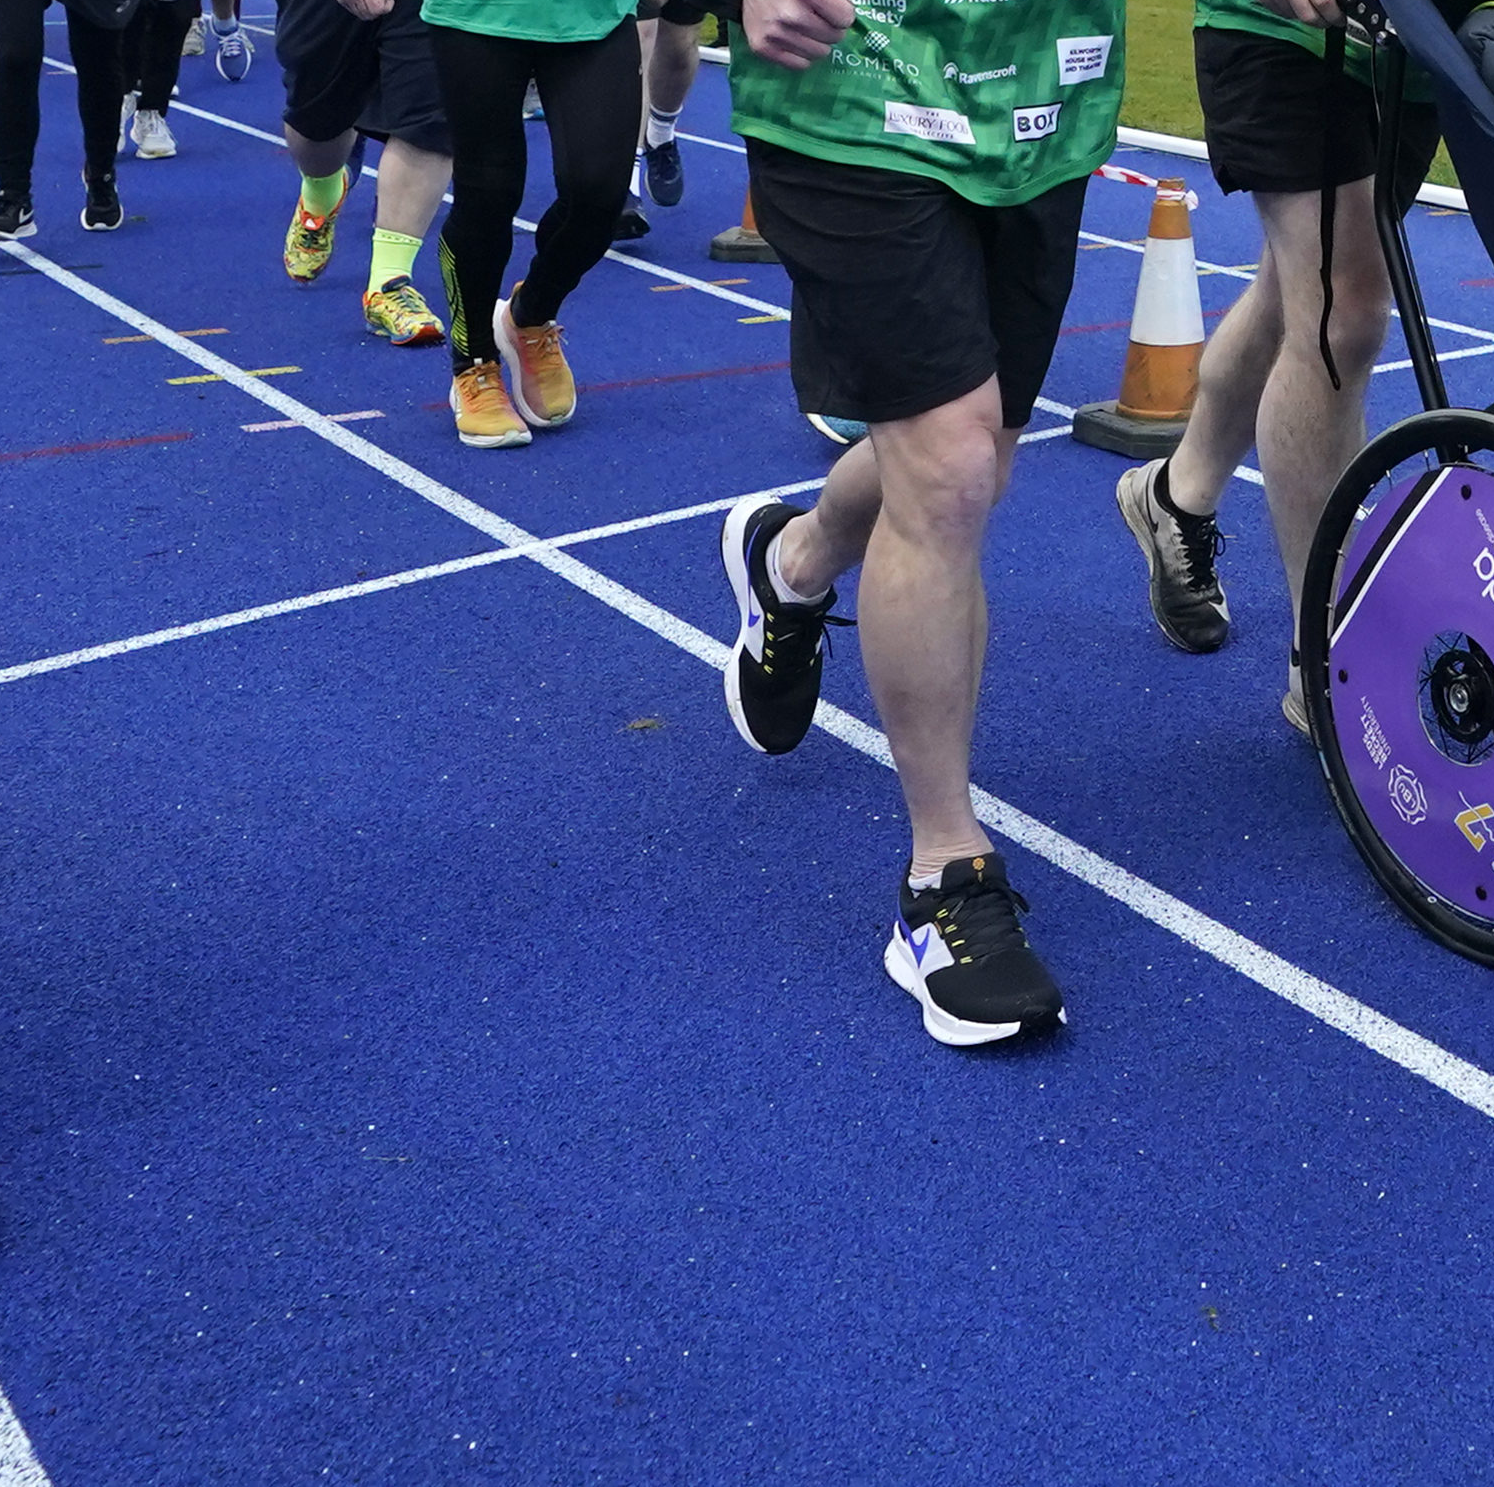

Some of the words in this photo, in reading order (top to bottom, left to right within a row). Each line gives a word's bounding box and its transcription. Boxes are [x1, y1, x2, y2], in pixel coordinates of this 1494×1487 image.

[831, 48, 920, 78] ROMERO
[959, 63, 1017, 84] Ravenscroft
[889, 112, 936, 130] LUXURY
[1016, 110, 1057, 133] BOX
